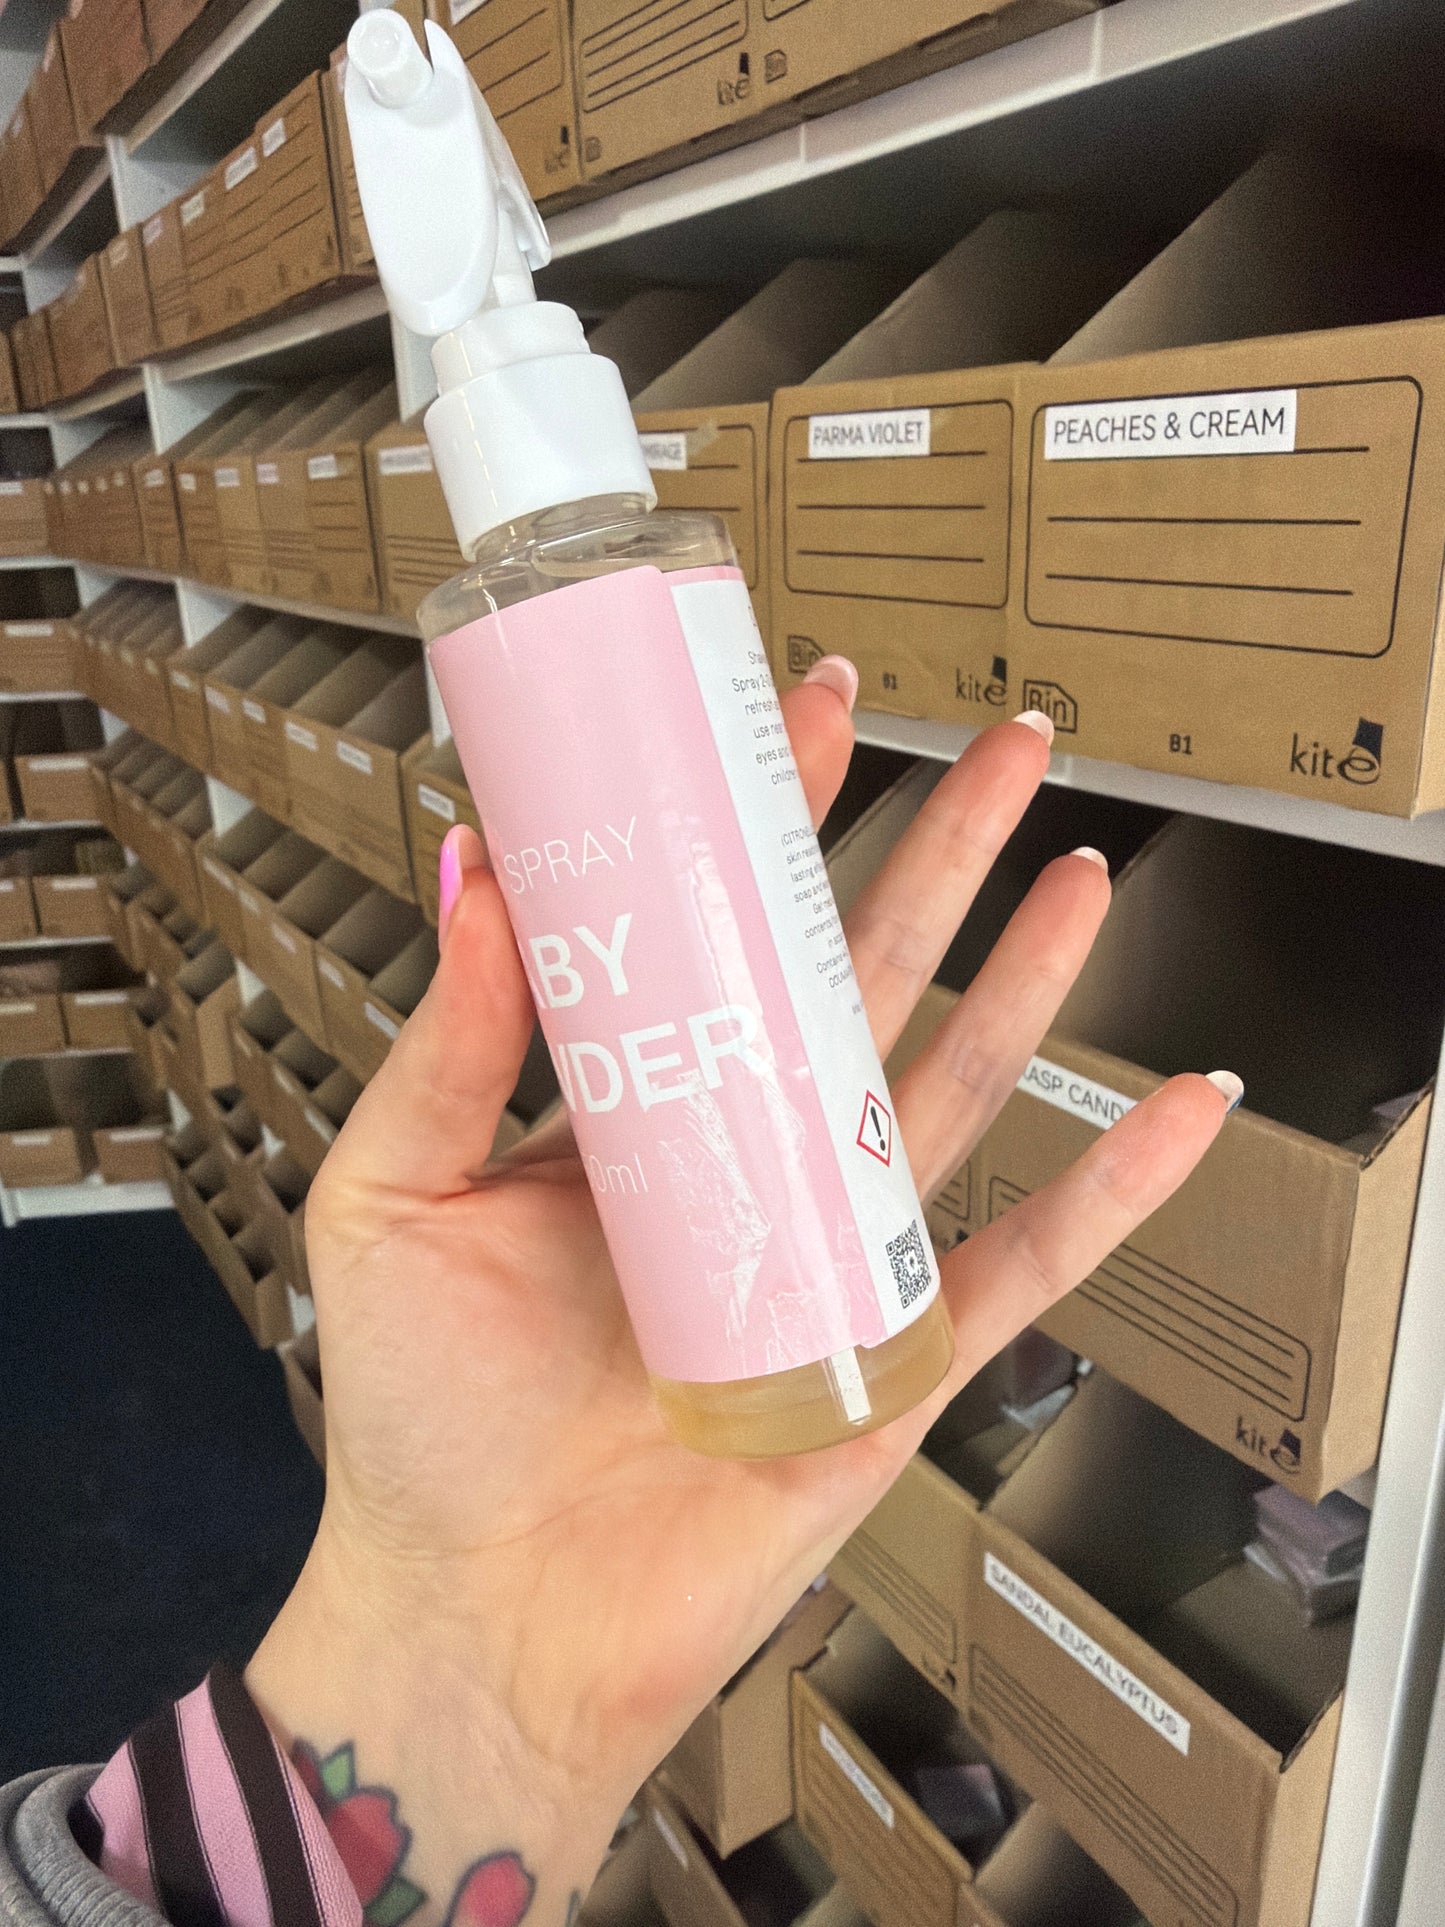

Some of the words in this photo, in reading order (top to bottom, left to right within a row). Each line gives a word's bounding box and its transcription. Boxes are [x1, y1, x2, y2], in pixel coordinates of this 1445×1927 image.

[812, 425, 865, 446] PARMA
[868, 421, 924, 445] VIOLET
[1053, 414, 1157, 444] PEACHES
[1163, 411, 1181, 440] &
[1189, 407, 1285, 439] CREAM
[956, 657, 1007, 707] kite
[1028, 688, 1068, 724] Bin
[756, 749, 778, 766] eyes
[1290, 720, 1383, 786] kite
[503, 816, 636, 894] SPRAY
[1068, 1083, 1127, 1122] CAND
[1235, 1415, 1302, 1475] kite
